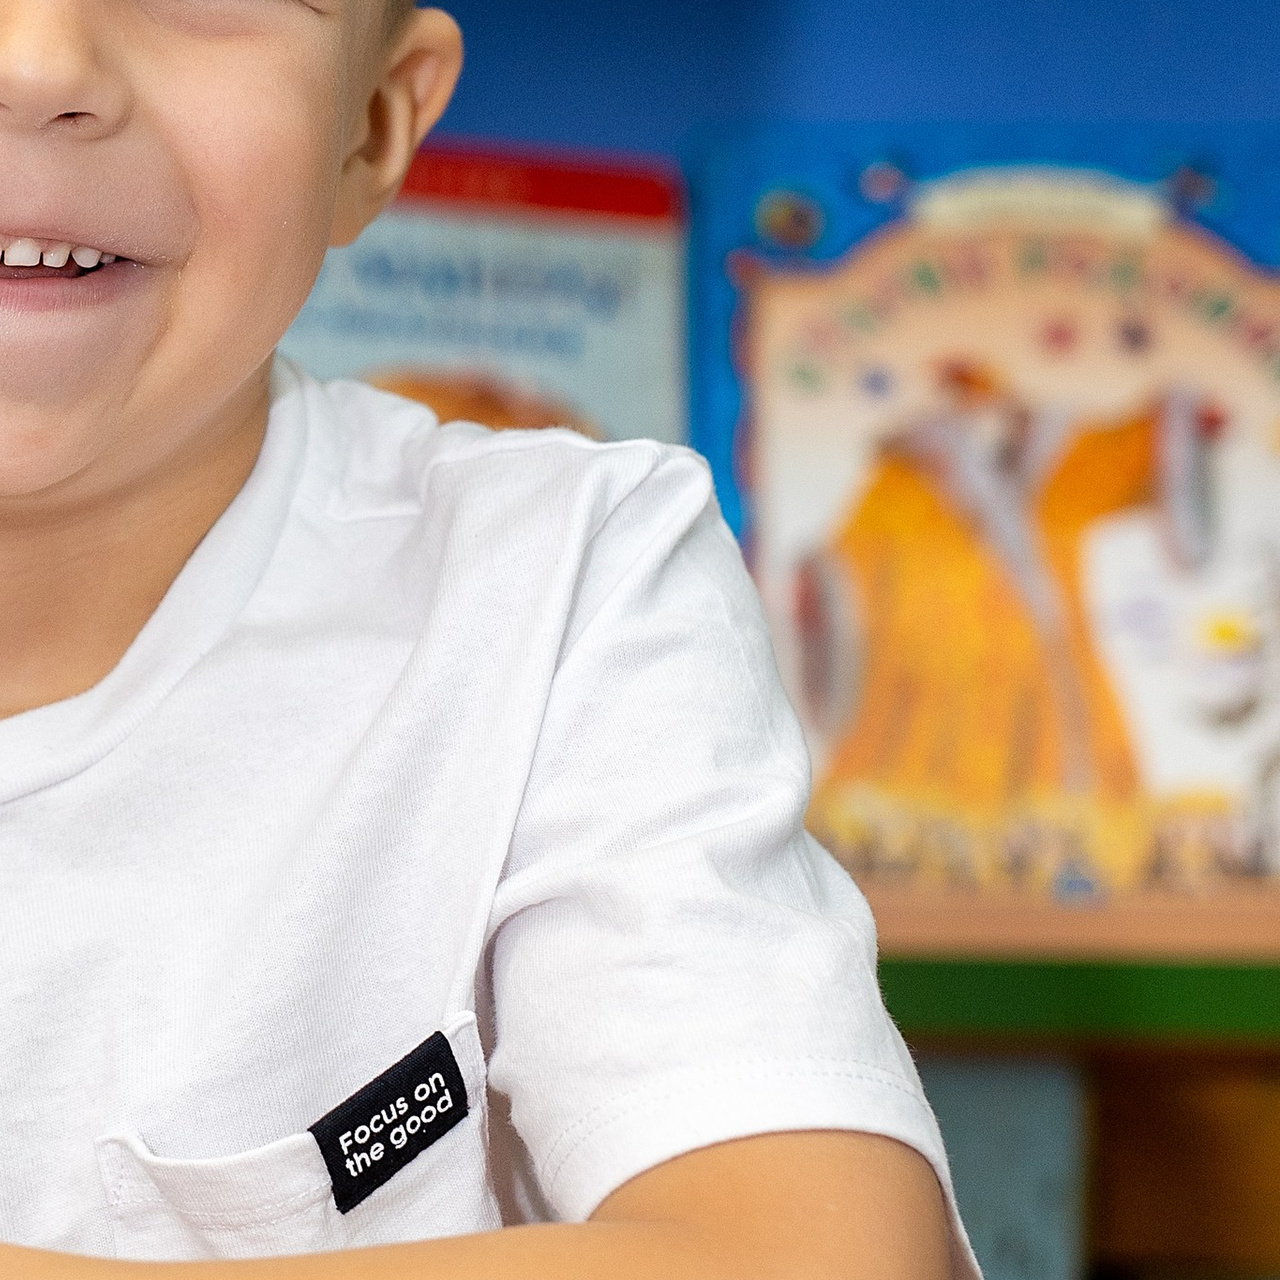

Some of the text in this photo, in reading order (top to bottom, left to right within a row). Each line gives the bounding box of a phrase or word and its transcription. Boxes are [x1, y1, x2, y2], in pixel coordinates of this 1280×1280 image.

[339, 1072, 445, 1155] Focus on
[345, 1089, 454, 1177] the good
